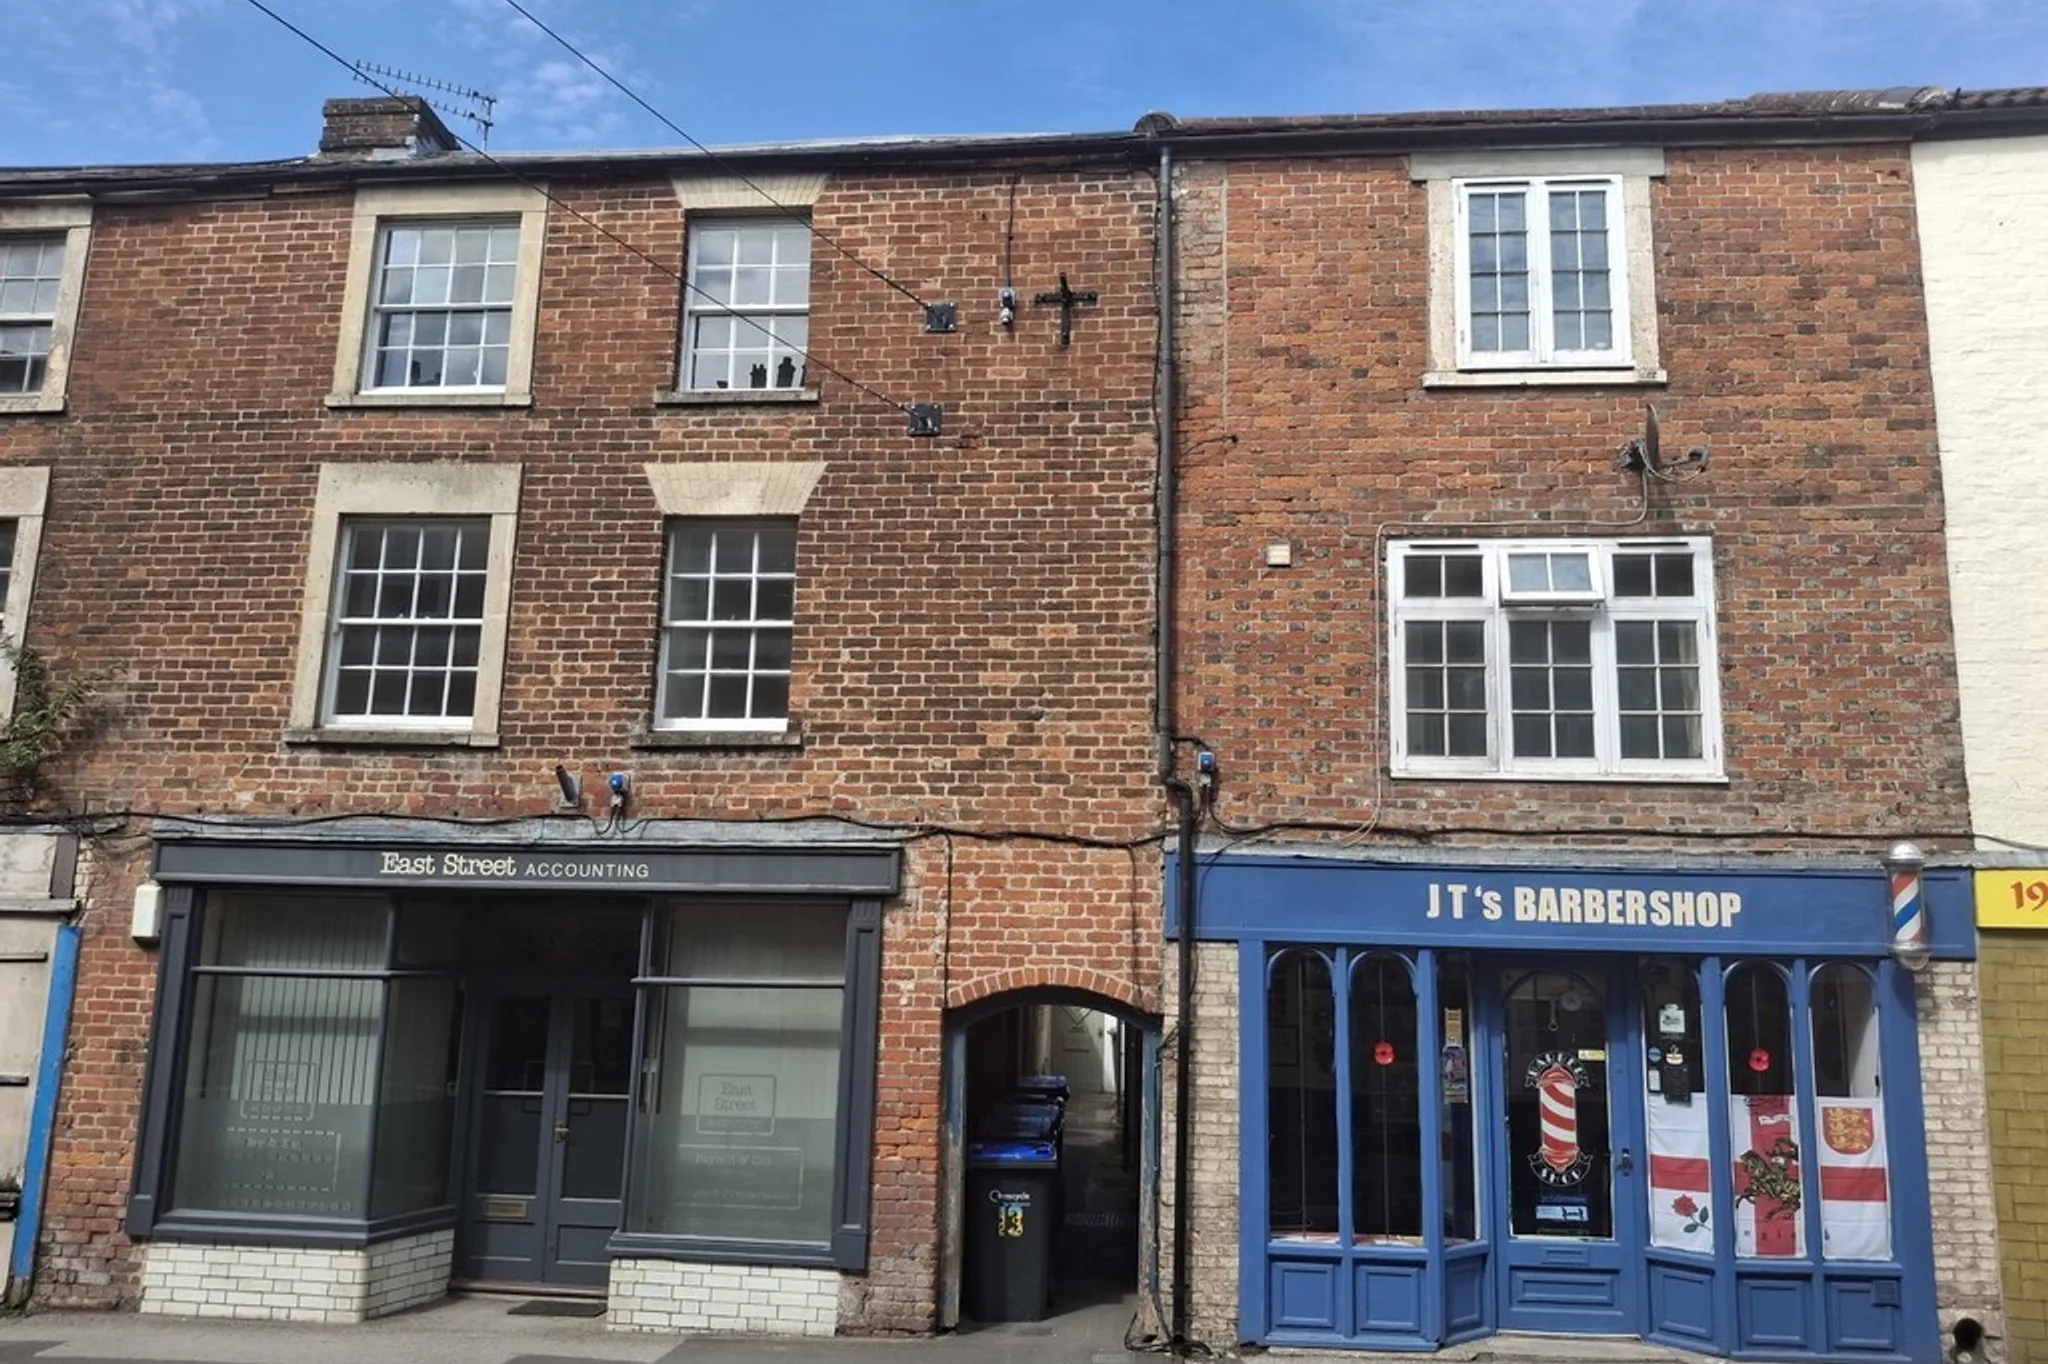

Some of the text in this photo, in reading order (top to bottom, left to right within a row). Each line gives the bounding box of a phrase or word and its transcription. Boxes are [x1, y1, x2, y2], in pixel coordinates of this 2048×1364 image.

[380, 852, 649, 878] East Street ACCOUNTING
[1513, 886, 1742, 928] BARBERSHOP
[721, 1082, 753, 1096] East
[714, 1097, 758, 1112] Street
